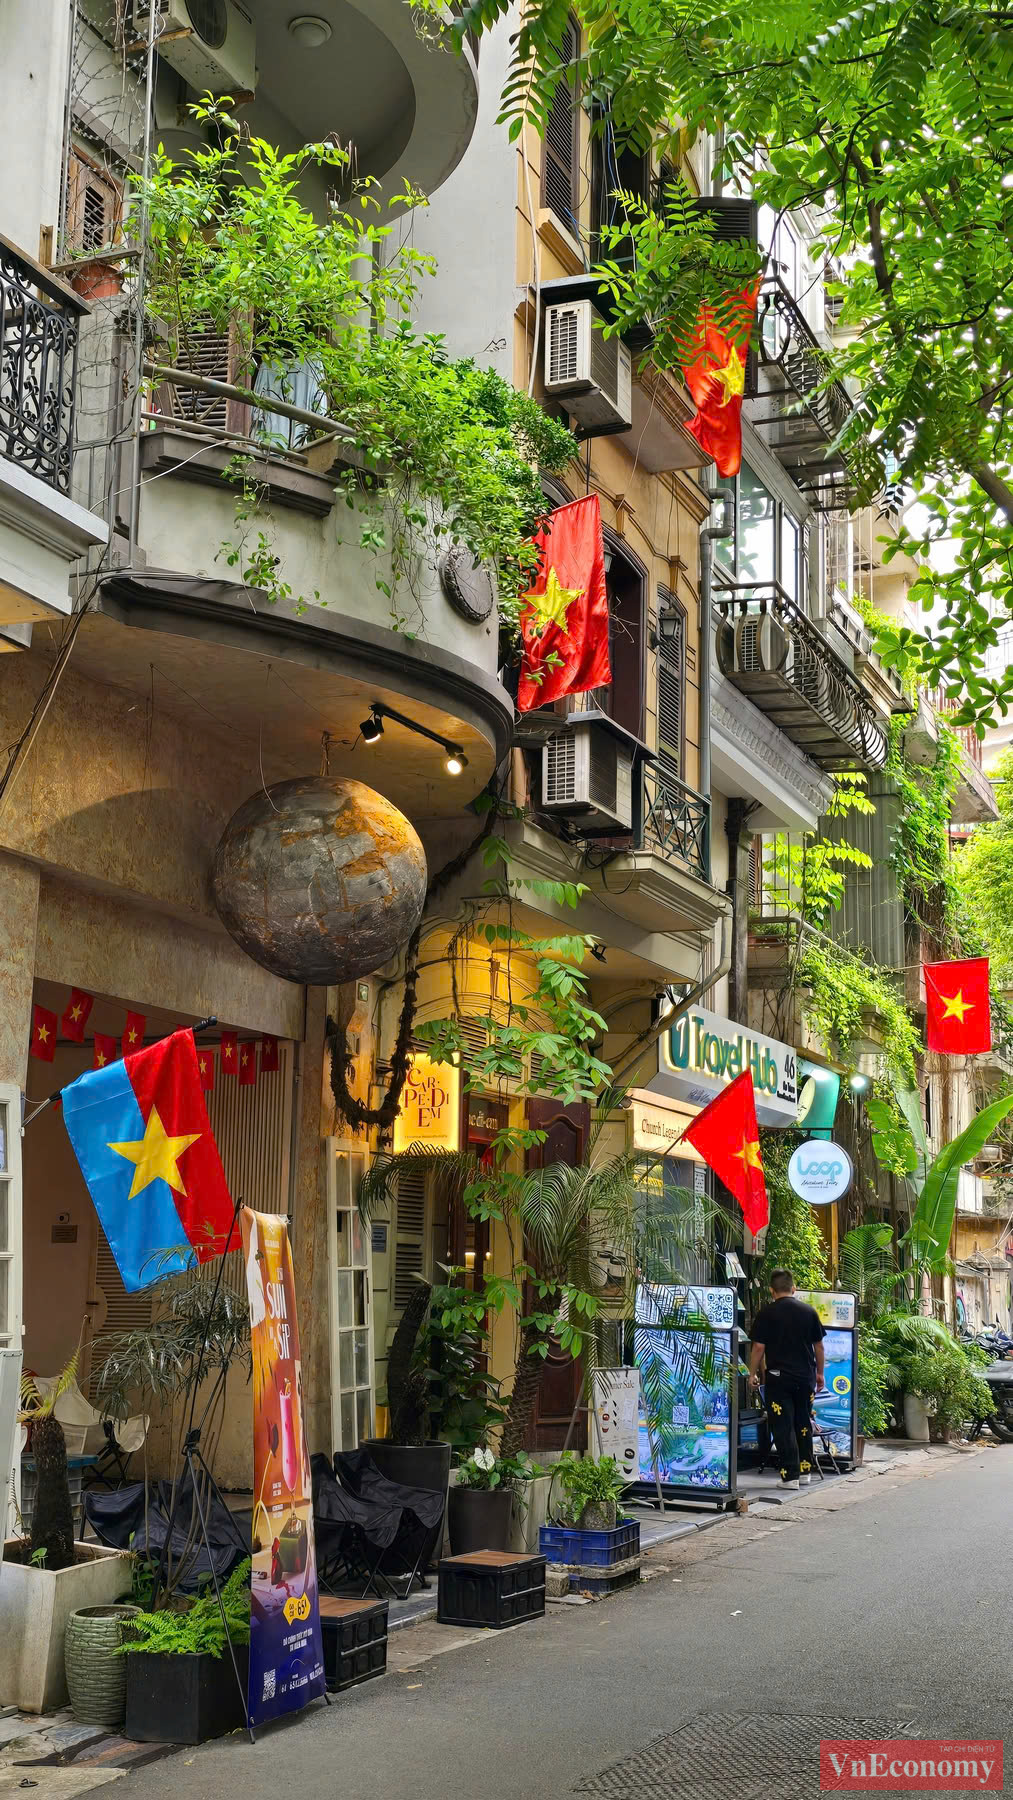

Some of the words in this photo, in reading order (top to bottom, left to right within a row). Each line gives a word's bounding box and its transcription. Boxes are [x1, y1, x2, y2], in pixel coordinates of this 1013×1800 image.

[692, 1016, 743, 1080] Travel
[746, 1040, 778, 1095] Hub
[784, 1054, 795, 1080] 46
[641, 1118, 661, 1137] Church
[266, 1281, 288, 1320] SUN
